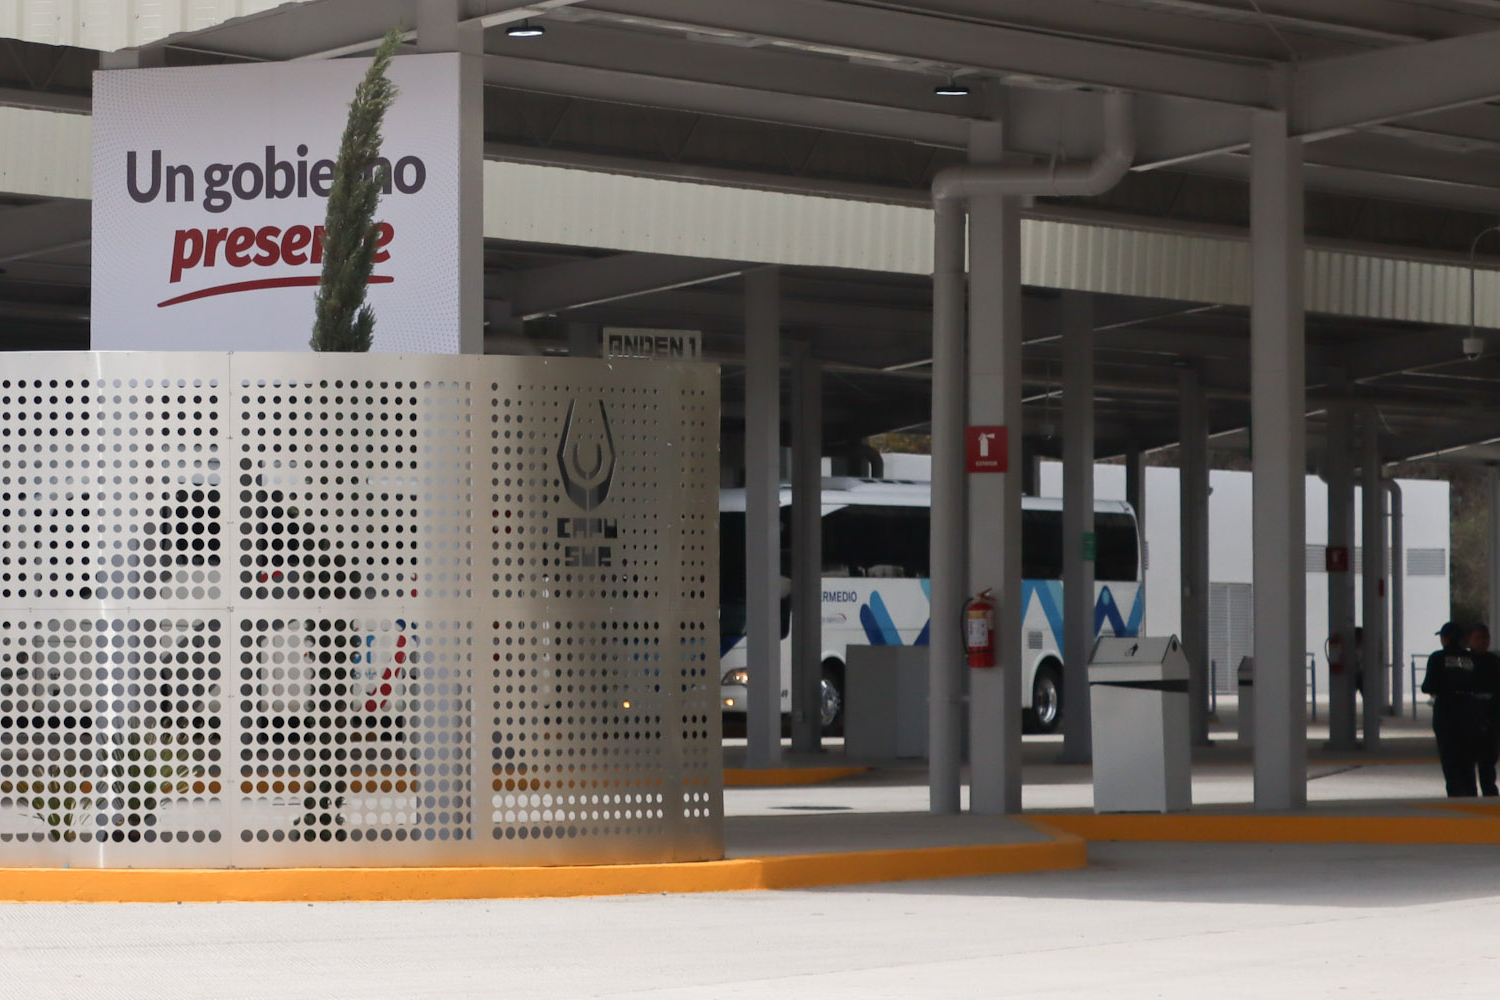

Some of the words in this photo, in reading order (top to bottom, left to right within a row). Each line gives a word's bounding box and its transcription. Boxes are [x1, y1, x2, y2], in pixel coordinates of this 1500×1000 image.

[126, 149, 195, 204] Un
[202, 144, 427, 214] gobieno
[608, 333, 684, 357] ANDEN
[688, 336, 697, 357] 1
[557, 517, 618, 539] CAPU
[564, 546, 612, 567] SUR
